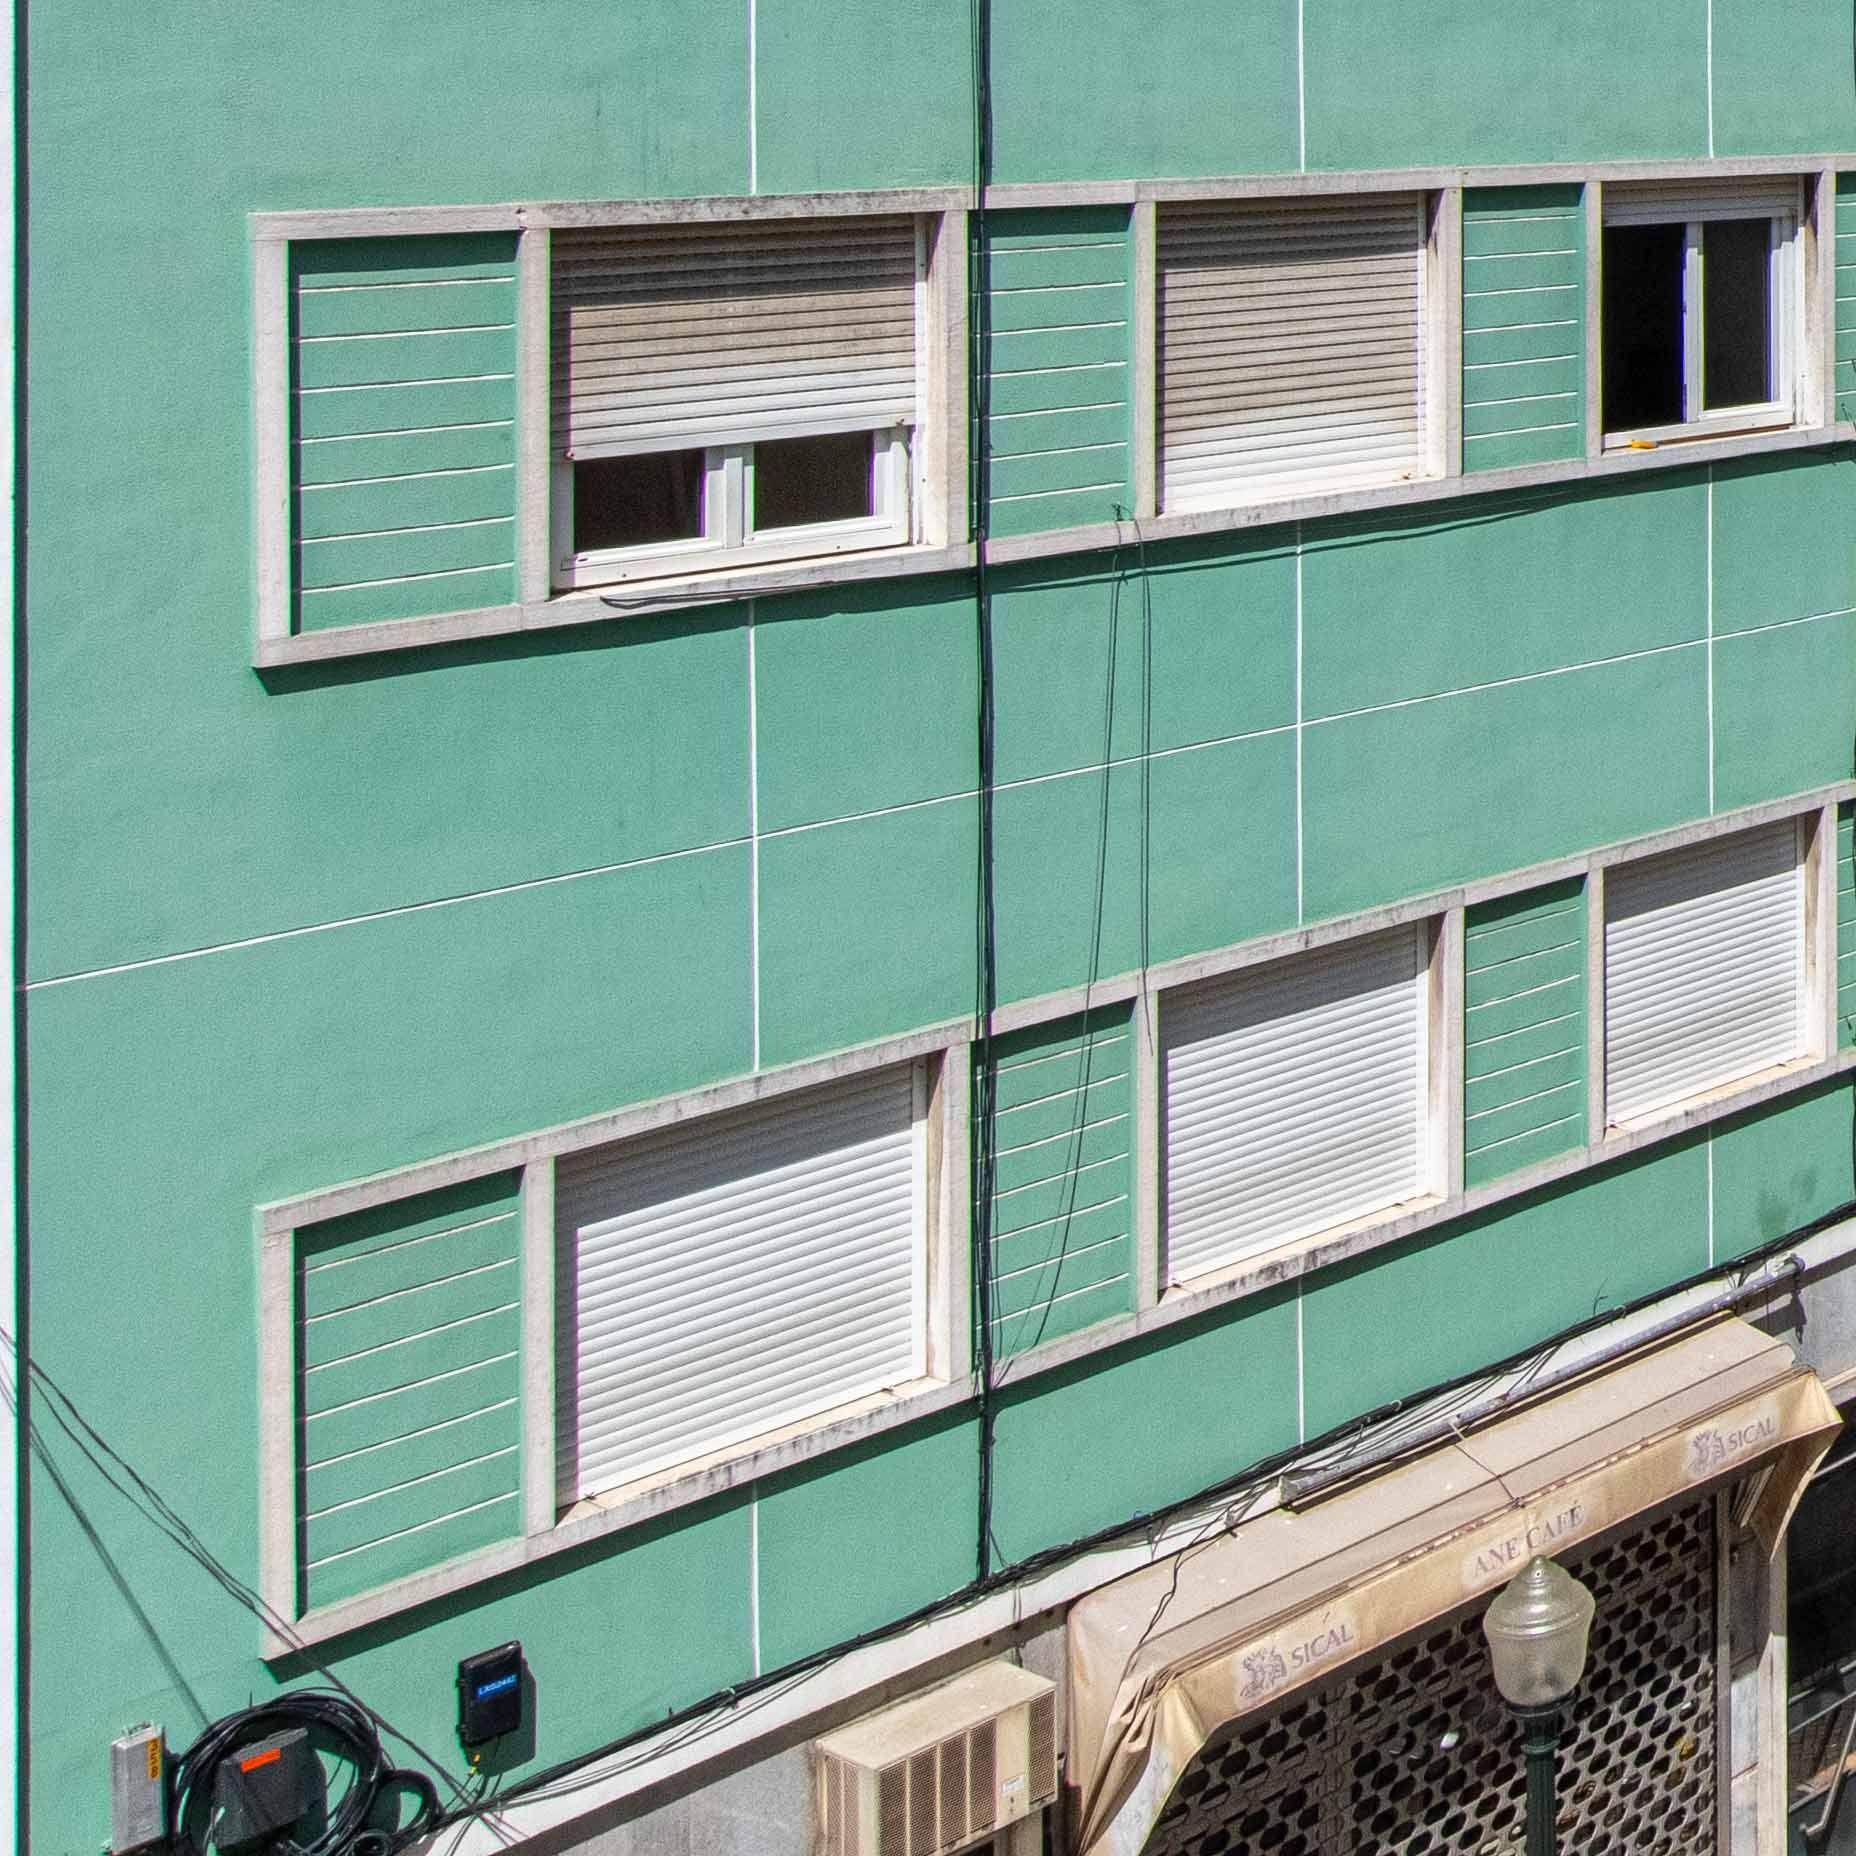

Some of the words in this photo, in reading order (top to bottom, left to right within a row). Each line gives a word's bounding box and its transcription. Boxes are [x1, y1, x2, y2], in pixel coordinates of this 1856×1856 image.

[1728, 1416, 1777, 1452] SICAL
[1473, 1536, 1521, 1578] ANE
[1525, 1499, 1585, 1549] CAFÉ
[1290, 1624, 1355, 1670] SICAL
